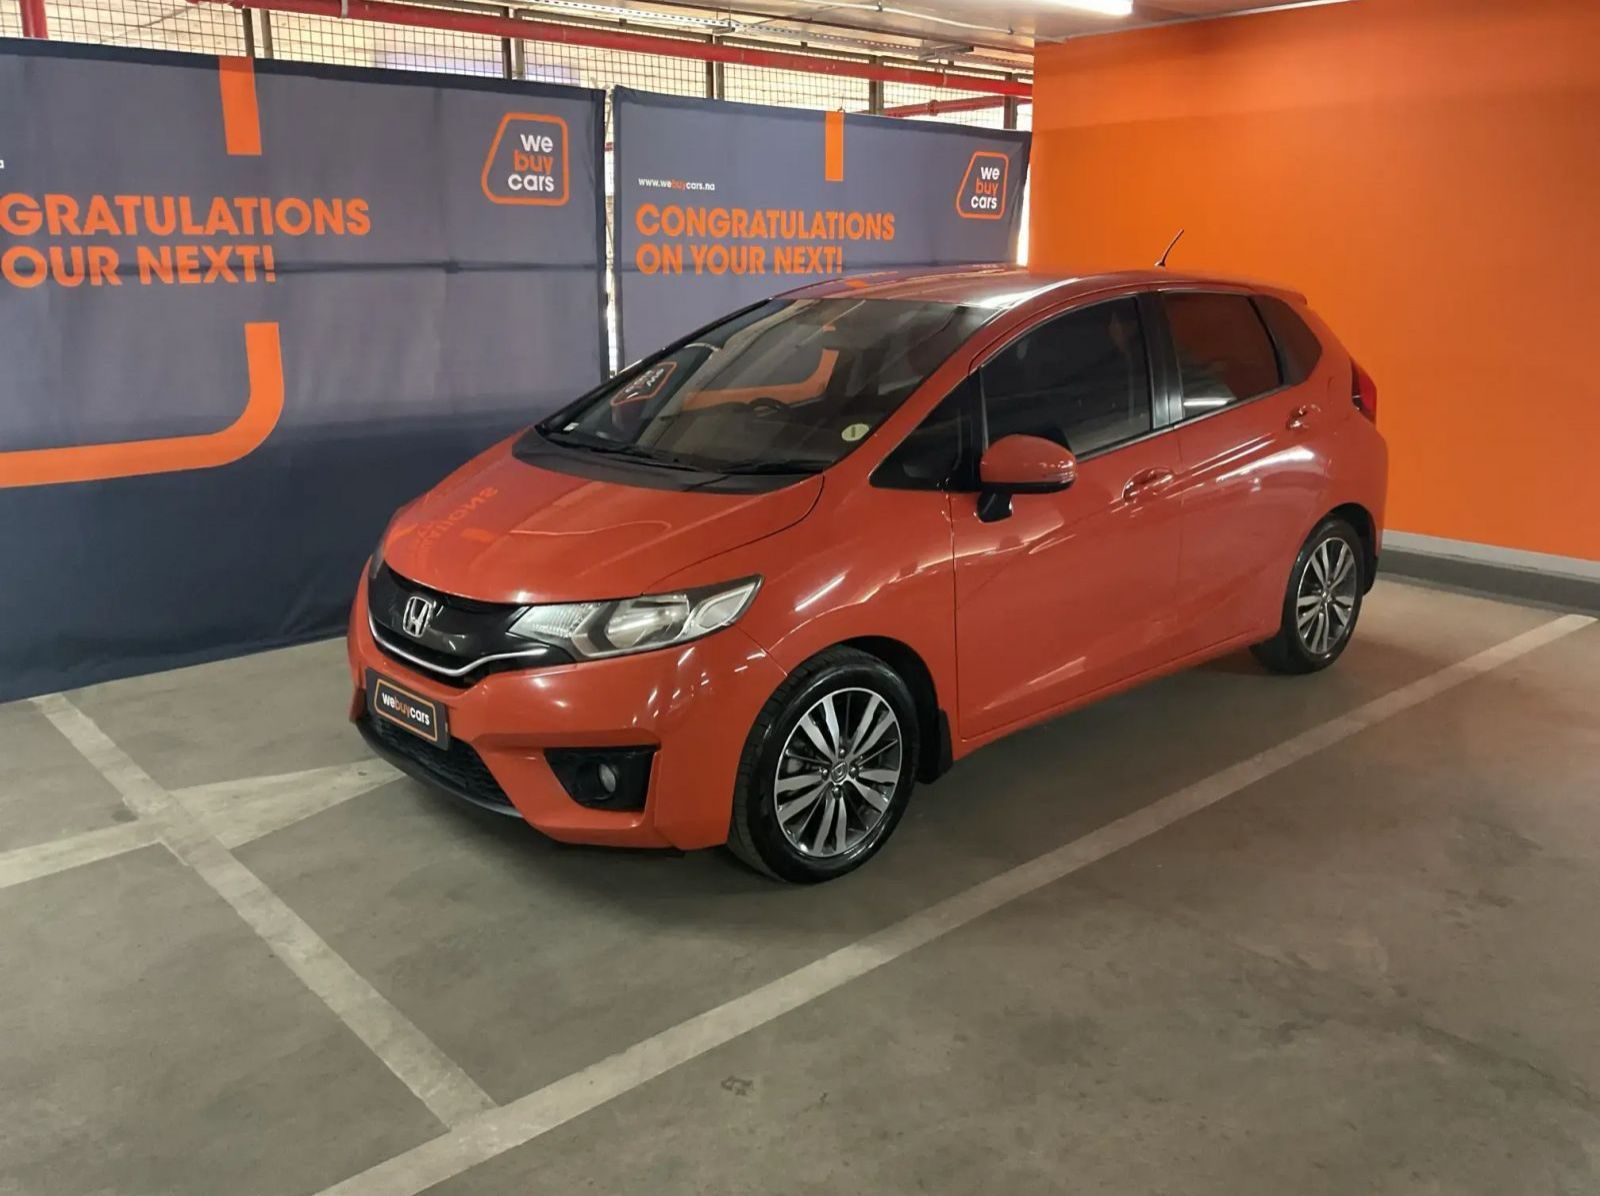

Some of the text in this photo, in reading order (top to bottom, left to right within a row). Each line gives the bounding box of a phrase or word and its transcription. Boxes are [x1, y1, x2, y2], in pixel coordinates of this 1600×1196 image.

[520, 134, 553, 153] we
[513, 149, 553, 175] buy
[980, 166, 1000, 180] we
[507, 173, 555, 192] cars
[975, 178, 998, 197] buy
[0, 193, 371, 235] GRATULATIONS
[970, 195, 998, 209] cars
[635, 203, 896, 240] CONGRATULATIONS
[1, 245, 276, 288] OUR NEXT!
[635, 243, 843, 276] ON YOUR NEXT!
[381, 692, 430, 725] webuycars
